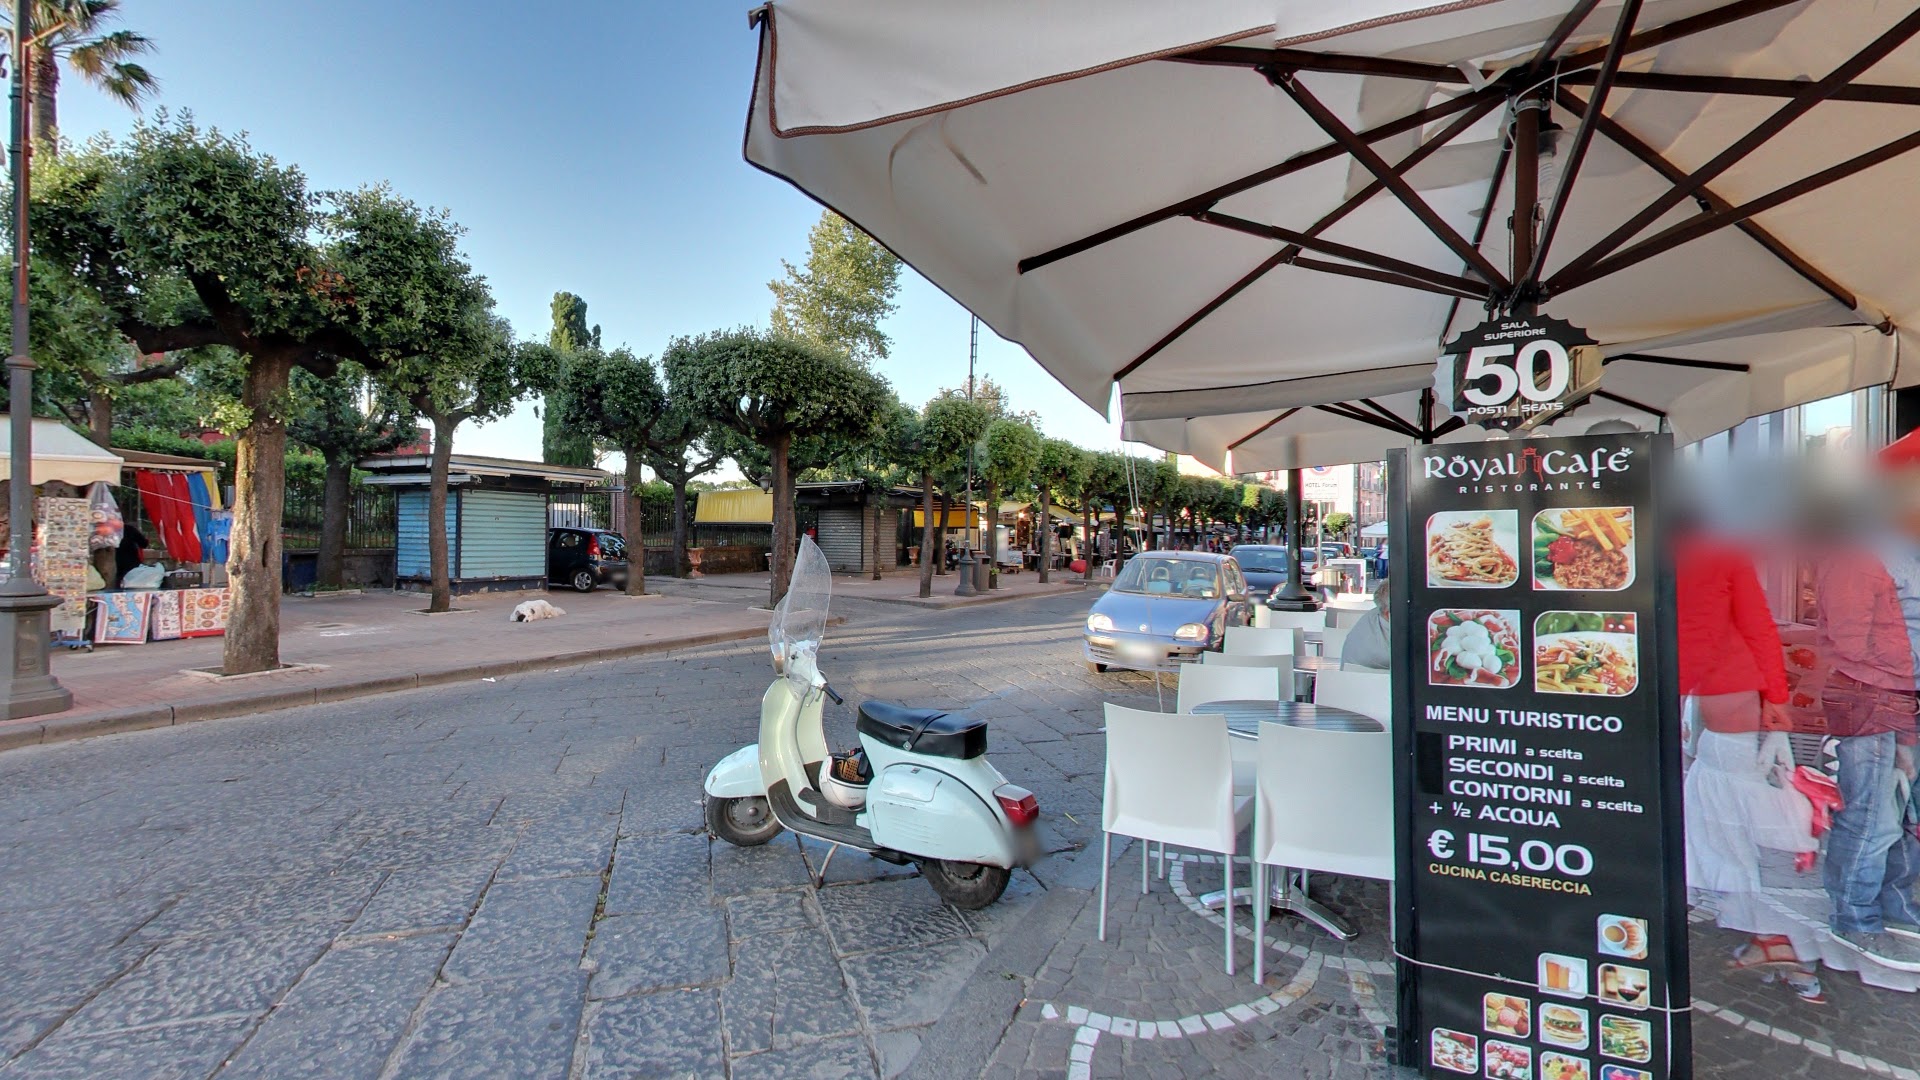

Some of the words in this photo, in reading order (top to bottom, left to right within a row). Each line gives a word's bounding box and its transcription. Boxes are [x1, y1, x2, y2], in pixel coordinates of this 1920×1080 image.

[1483, 327, 1547, 341] SUPERIORE
[1501, 320, 1530, 330] SALA
[1463, 339, 1570, 406] 50
[1467, 405, 1507, 416] POSTI
[1520, 402, 1564, 414] SEATS
[1458, 481, 1602, 494] RISTORANTE
[1425, 704, 1490, 724] MENU
[1495, 708, 1624, 733] TURISTICO
[1448, 734, 1517, 755] PRIMI
[1525, 747, 1535, 757] a
[1539, 747, 1583, 761] scelta
[1448, 757, 1554, 781] SECONDI
[1562, 773, 1573, 783] a
[1578, 774, 1625, 788] scelta
[1449, 779, 1572, 806] CONTORNI
[1581, 798, 1592, 808] a
[1597, 798, 1643, 814] scelta
[1478, 803, 1561, 828] ACQUA
[1427, 829, 1455, 859] €
[1468, 832, 1594, 876] 15,00
[1429, 862, 1487, 880] CUCINA
[1490, 871, 1592, 896] CASERECCIA
